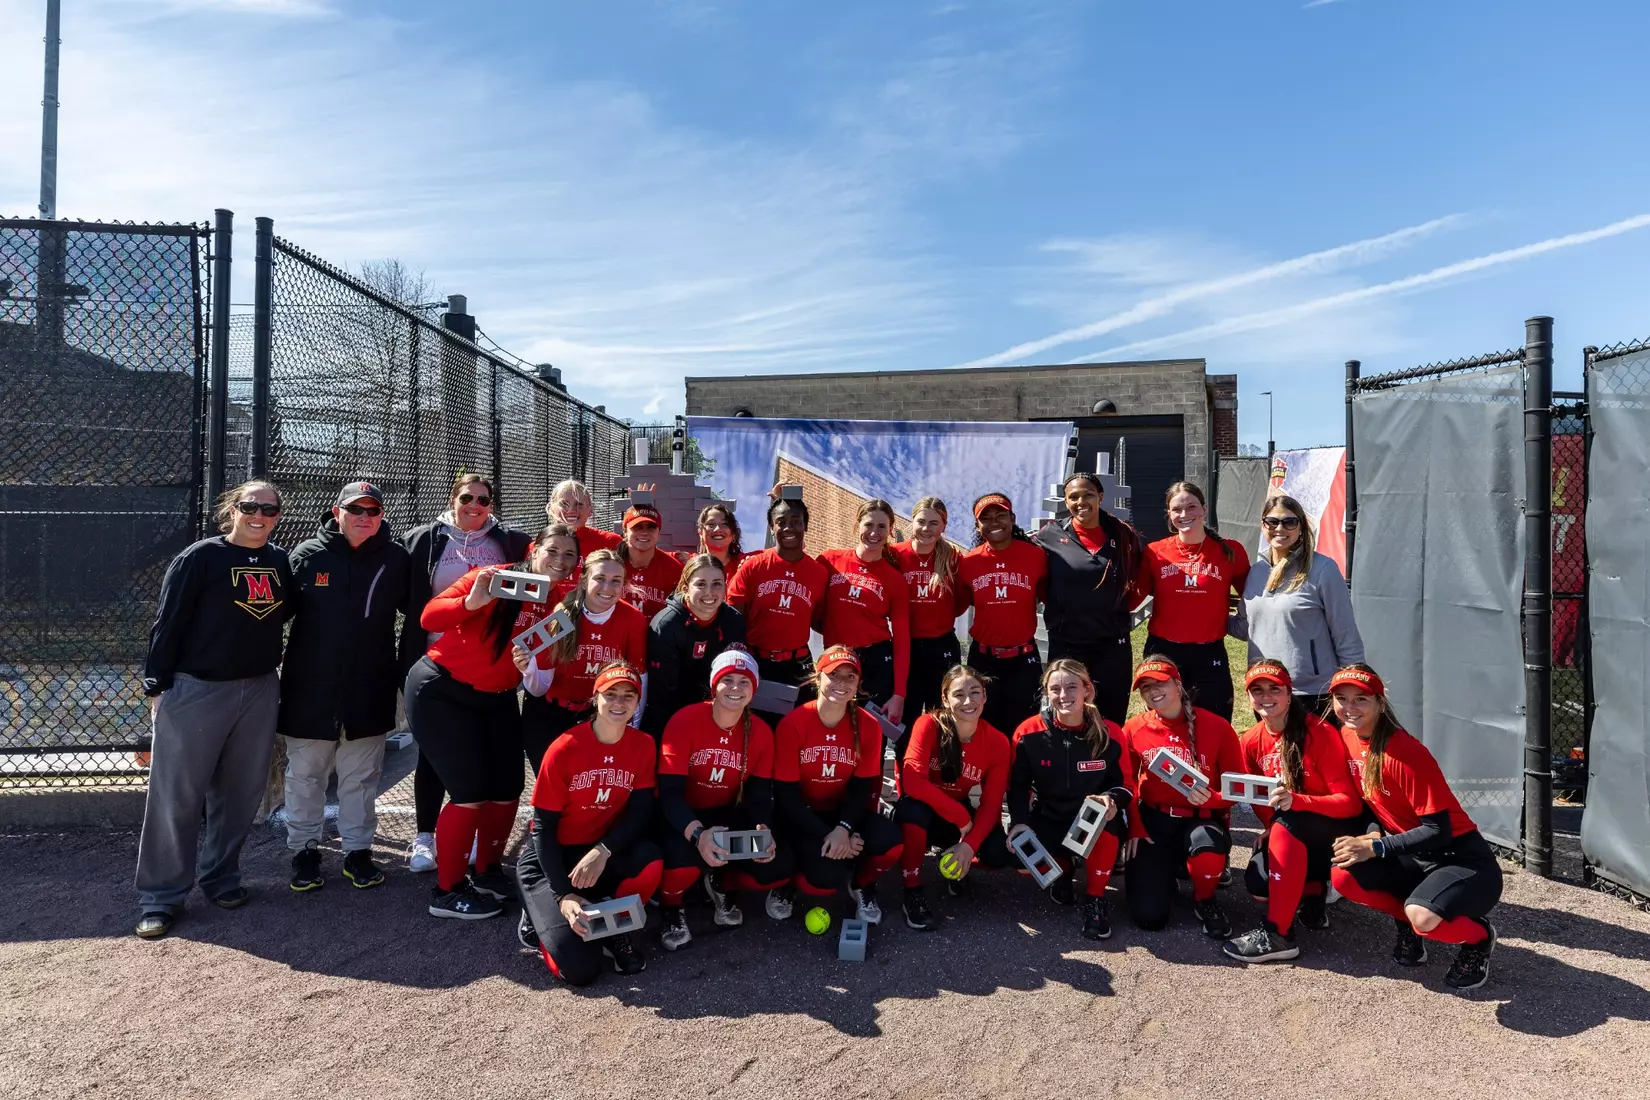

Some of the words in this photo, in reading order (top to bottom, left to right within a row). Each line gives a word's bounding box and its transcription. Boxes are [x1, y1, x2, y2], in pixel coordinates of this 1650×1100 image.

[316, 573, 329, 584] M
[1161, 562, 1222, 581] SOFTBALL
[244, 574, 274, 600] M
[830, 572, 884, 601] SOFTBALL
[972, 572, 1032, 592] SOFTBALL
[1184, 575, 1198, 587] M
[758, 579, 812, 607] SOFTBALL
[848, 585, 862, 598] M
[917, 585, 929, 598] M
[995, 586, 1008, 598] M
[779, 594, 792, 609] M
[585, 663, 600, 675] M
[709, 767, 725, 783] M
[821, 763, 836, 777] M
[569, 768, 634, 791] SOFTBALL
[594, 788, 612, 803] M
